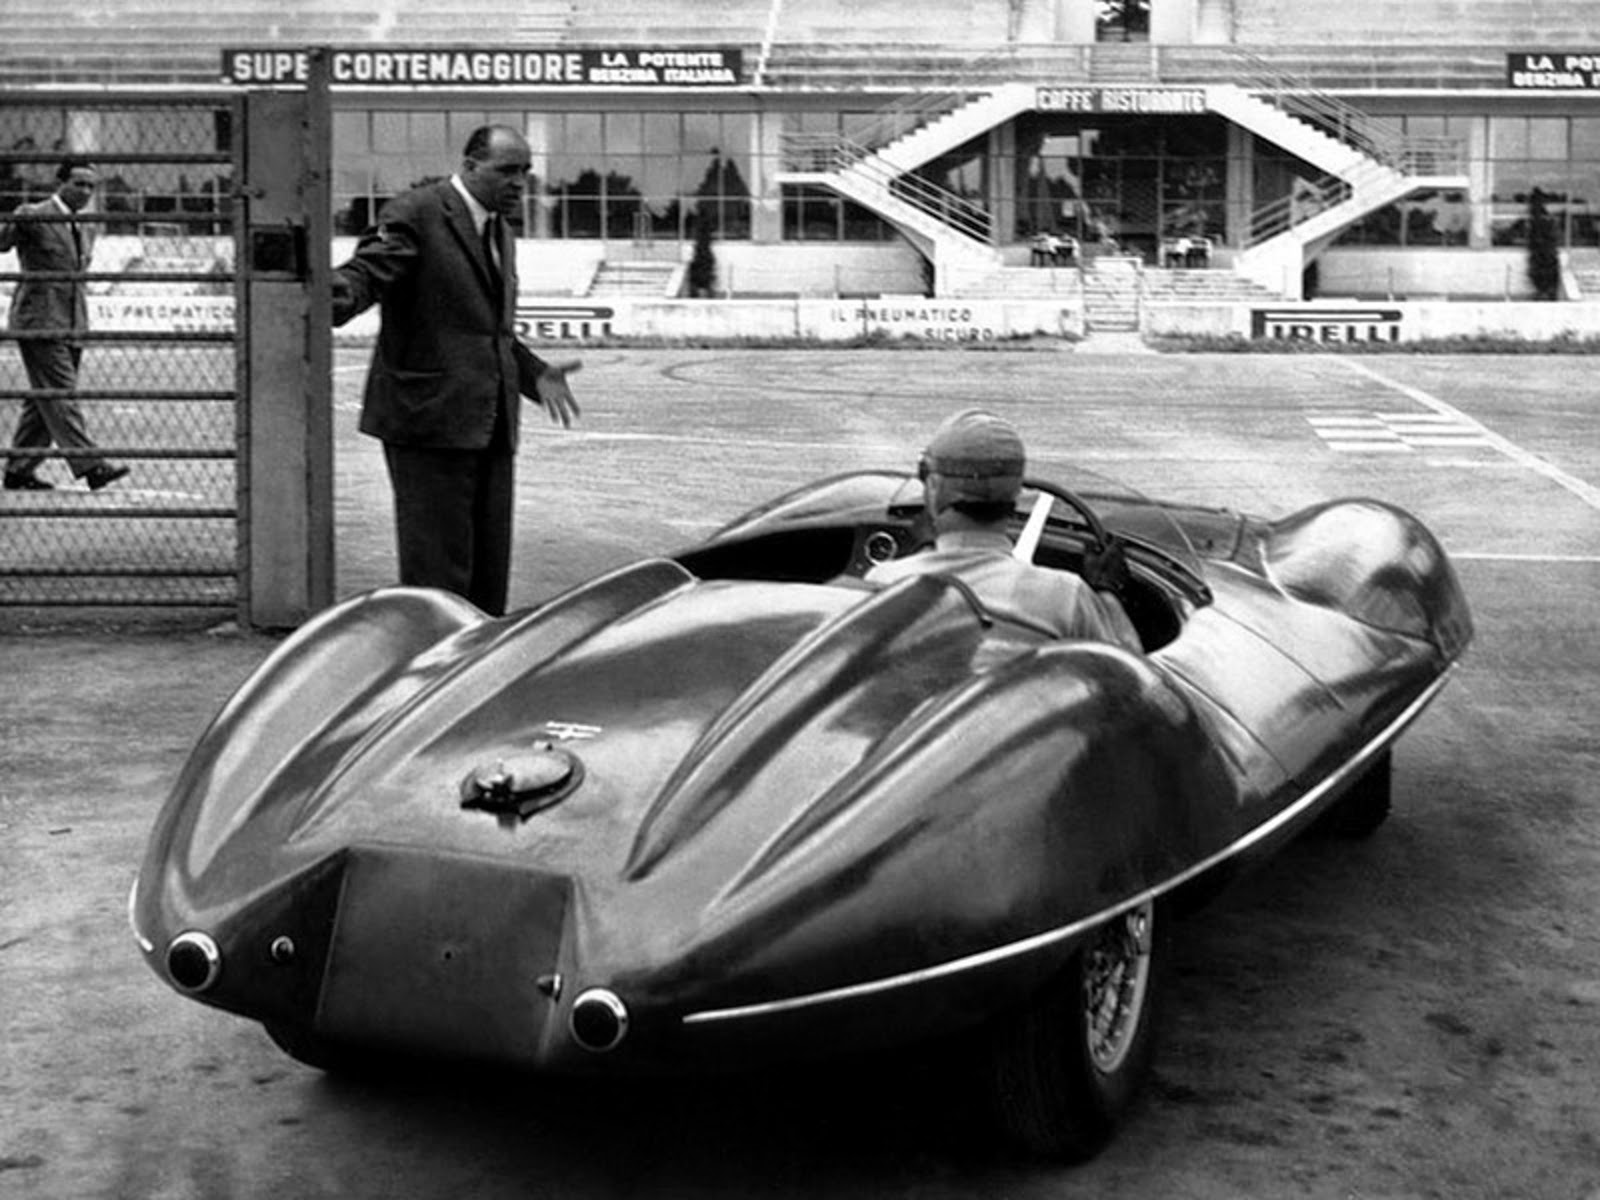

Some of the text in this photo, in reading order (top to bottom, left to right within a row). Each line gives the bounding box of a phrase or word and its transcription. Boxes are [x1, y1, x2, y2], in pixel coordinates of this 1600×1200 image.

[233, 53, 309, 80] SUPE
[602, 52, 723, 67] LA POTENTE
[1526, 55, 1555, 71] LA
[831, 308, 972, 323] IL PNEUMATICO
[1252, 310, 1402, 343] PIRELLI
